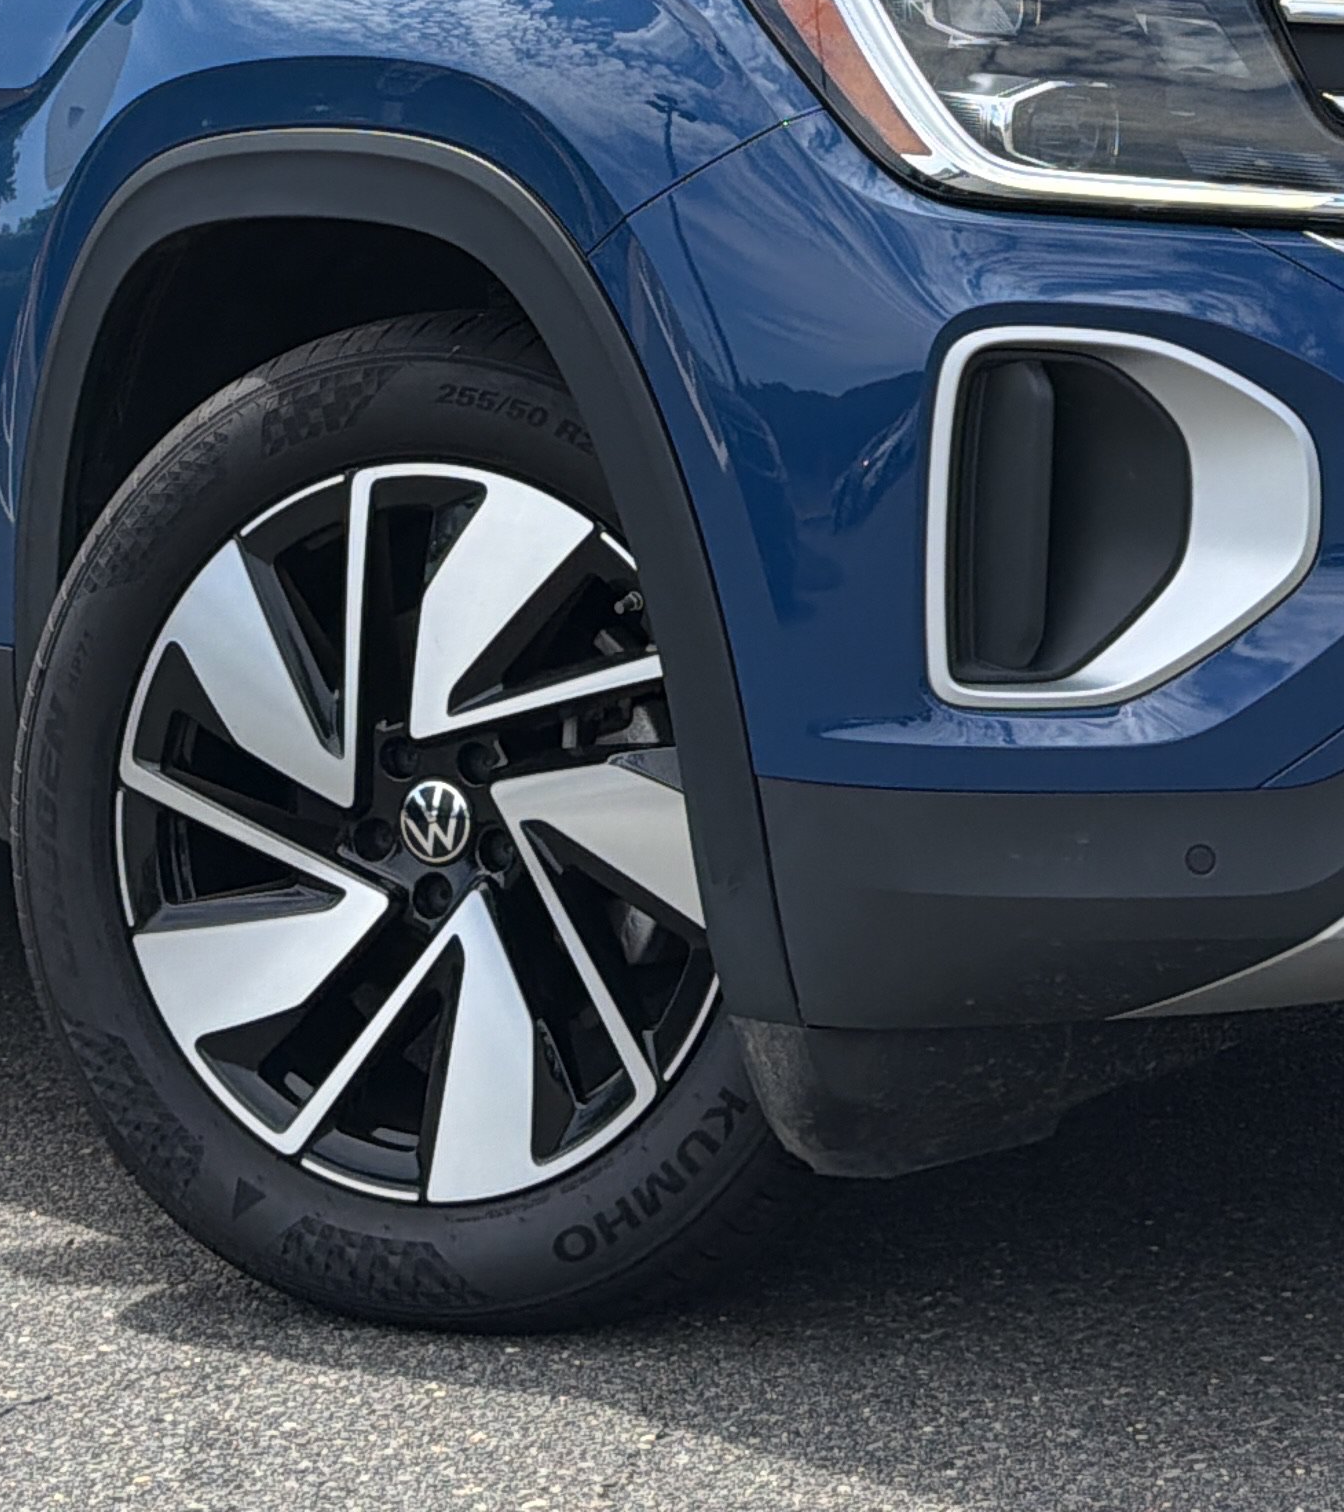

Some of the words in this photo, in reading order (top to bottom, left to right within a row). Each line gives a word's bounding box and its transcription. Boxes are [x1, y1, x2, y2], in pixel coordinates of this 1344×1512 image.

[434, 382, 549, 428] 255/50
[402, 782, 468, 859] VW
[552, 1086, 749, 1263] KUMHO
